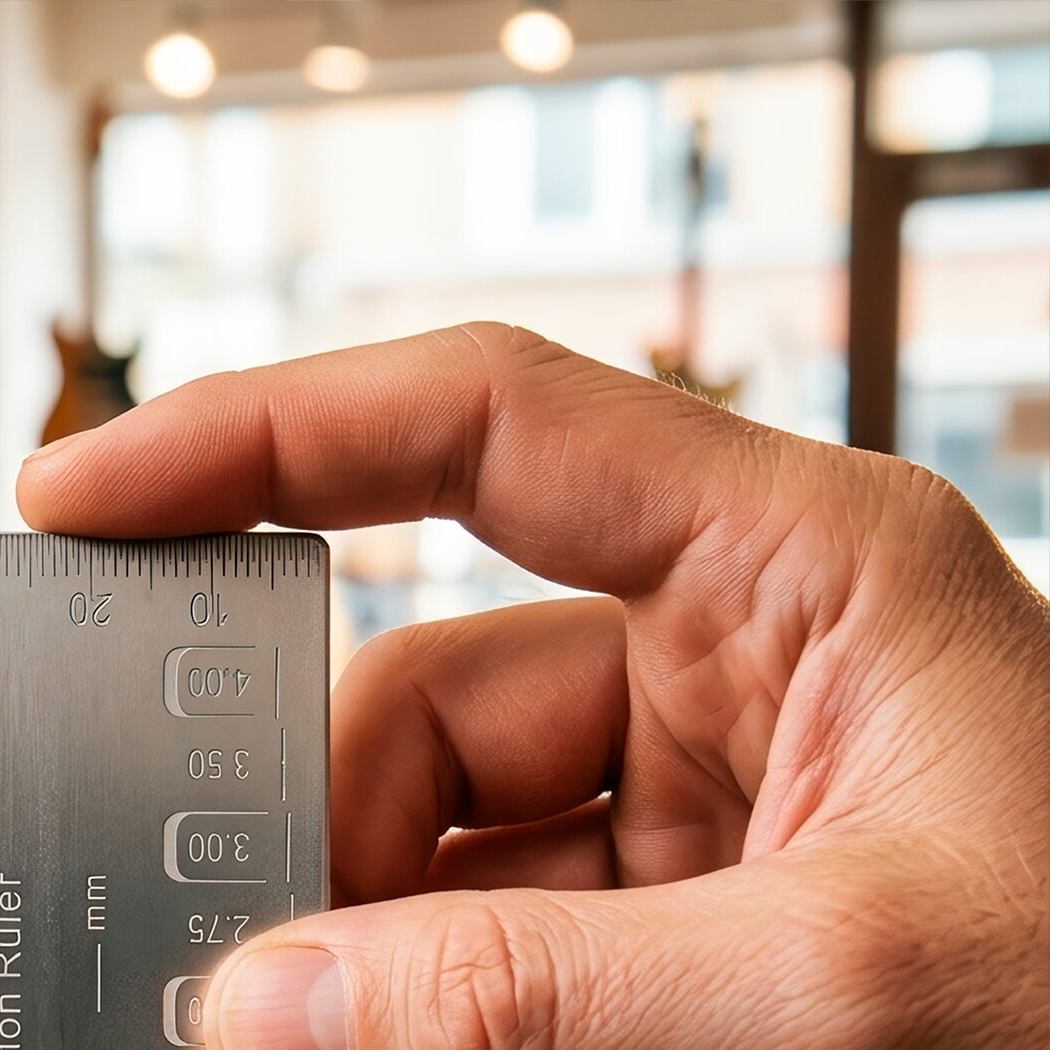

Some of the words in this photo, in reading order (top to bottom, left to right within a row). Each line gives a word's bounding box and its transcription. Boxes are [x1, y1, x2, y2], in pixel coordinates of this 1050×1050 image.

[188, 832, 250, 863] 3.00
[87, 874, 107, 930] mm
[188, 914, 250, 944] 2.75
